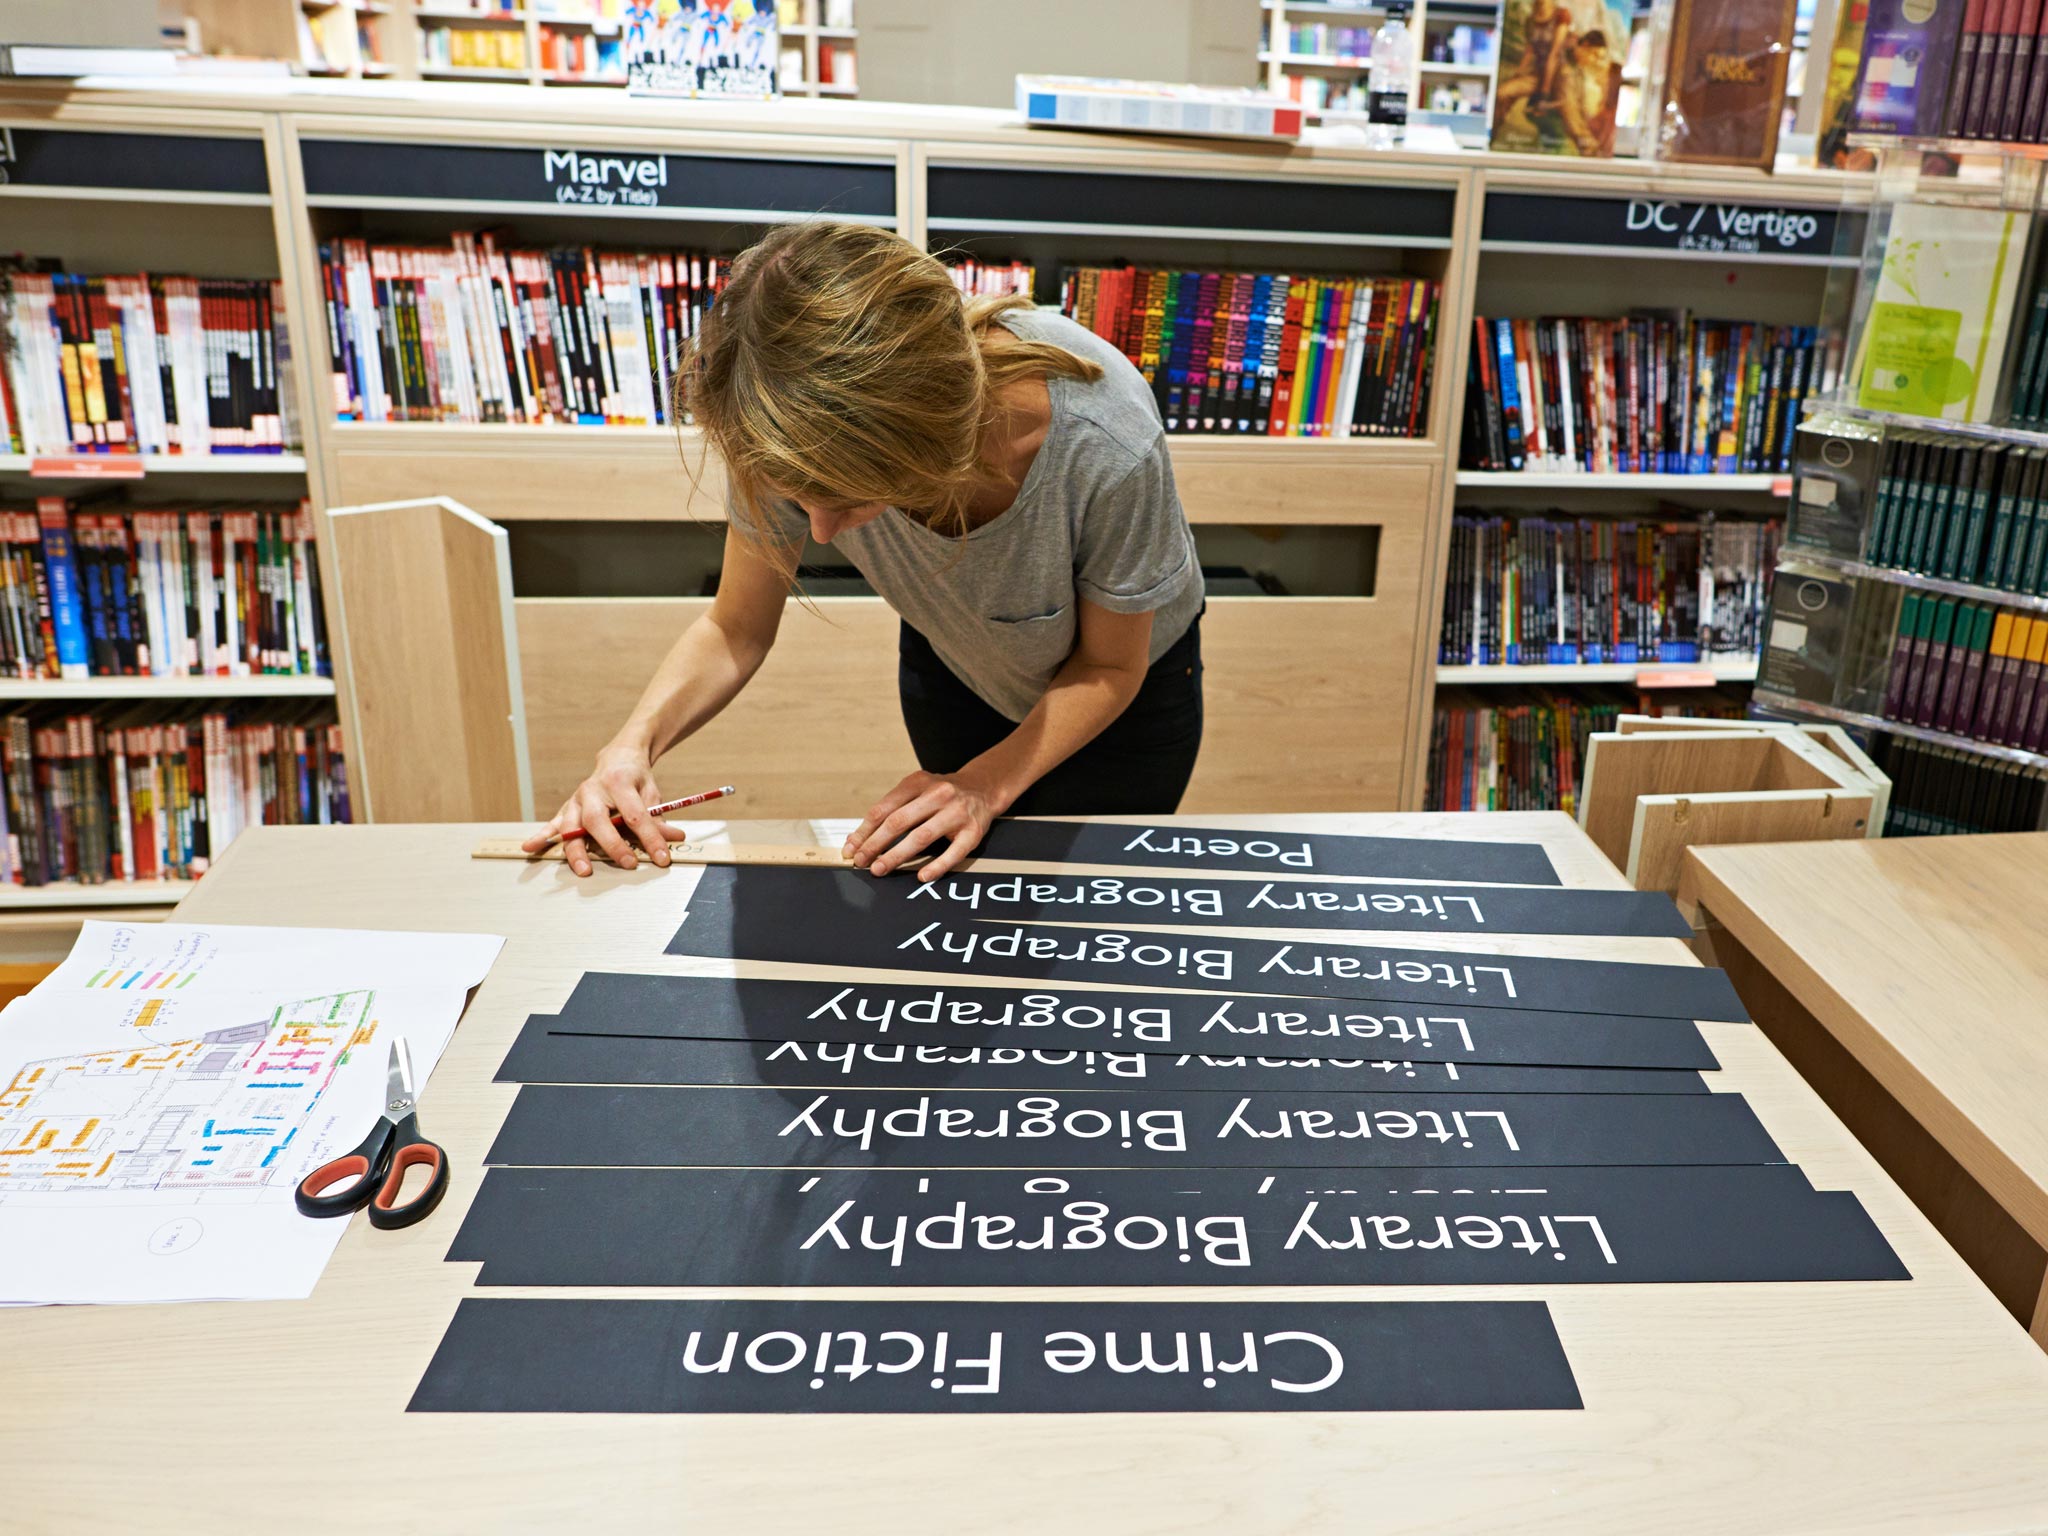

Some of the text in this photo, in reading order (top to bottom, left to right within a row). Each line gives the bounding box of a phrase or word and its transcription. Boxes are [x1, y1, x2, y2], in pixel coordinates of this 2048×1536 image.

[544, 151, 667, 186] Marvel
[555, 184, 658, 206] (A-Z by Title)
[1626, 200, 1818, 247] DC / Vertigo
[1710, 235, 1727, 251] by
[1123, 829, 1314, 867] Poetry
[906, 876, 1485, 924] Literary Biography
[896, 922, 1517, 998] Literary Biography
[806, 988, 1475, 1052] Literary Biography
[777, 1096, 1521, 1152] Literary Biography
[799, 1200, 1618, 1267] Literary Biography
[683, 1331, 1344, 1395] Crime Fiction
